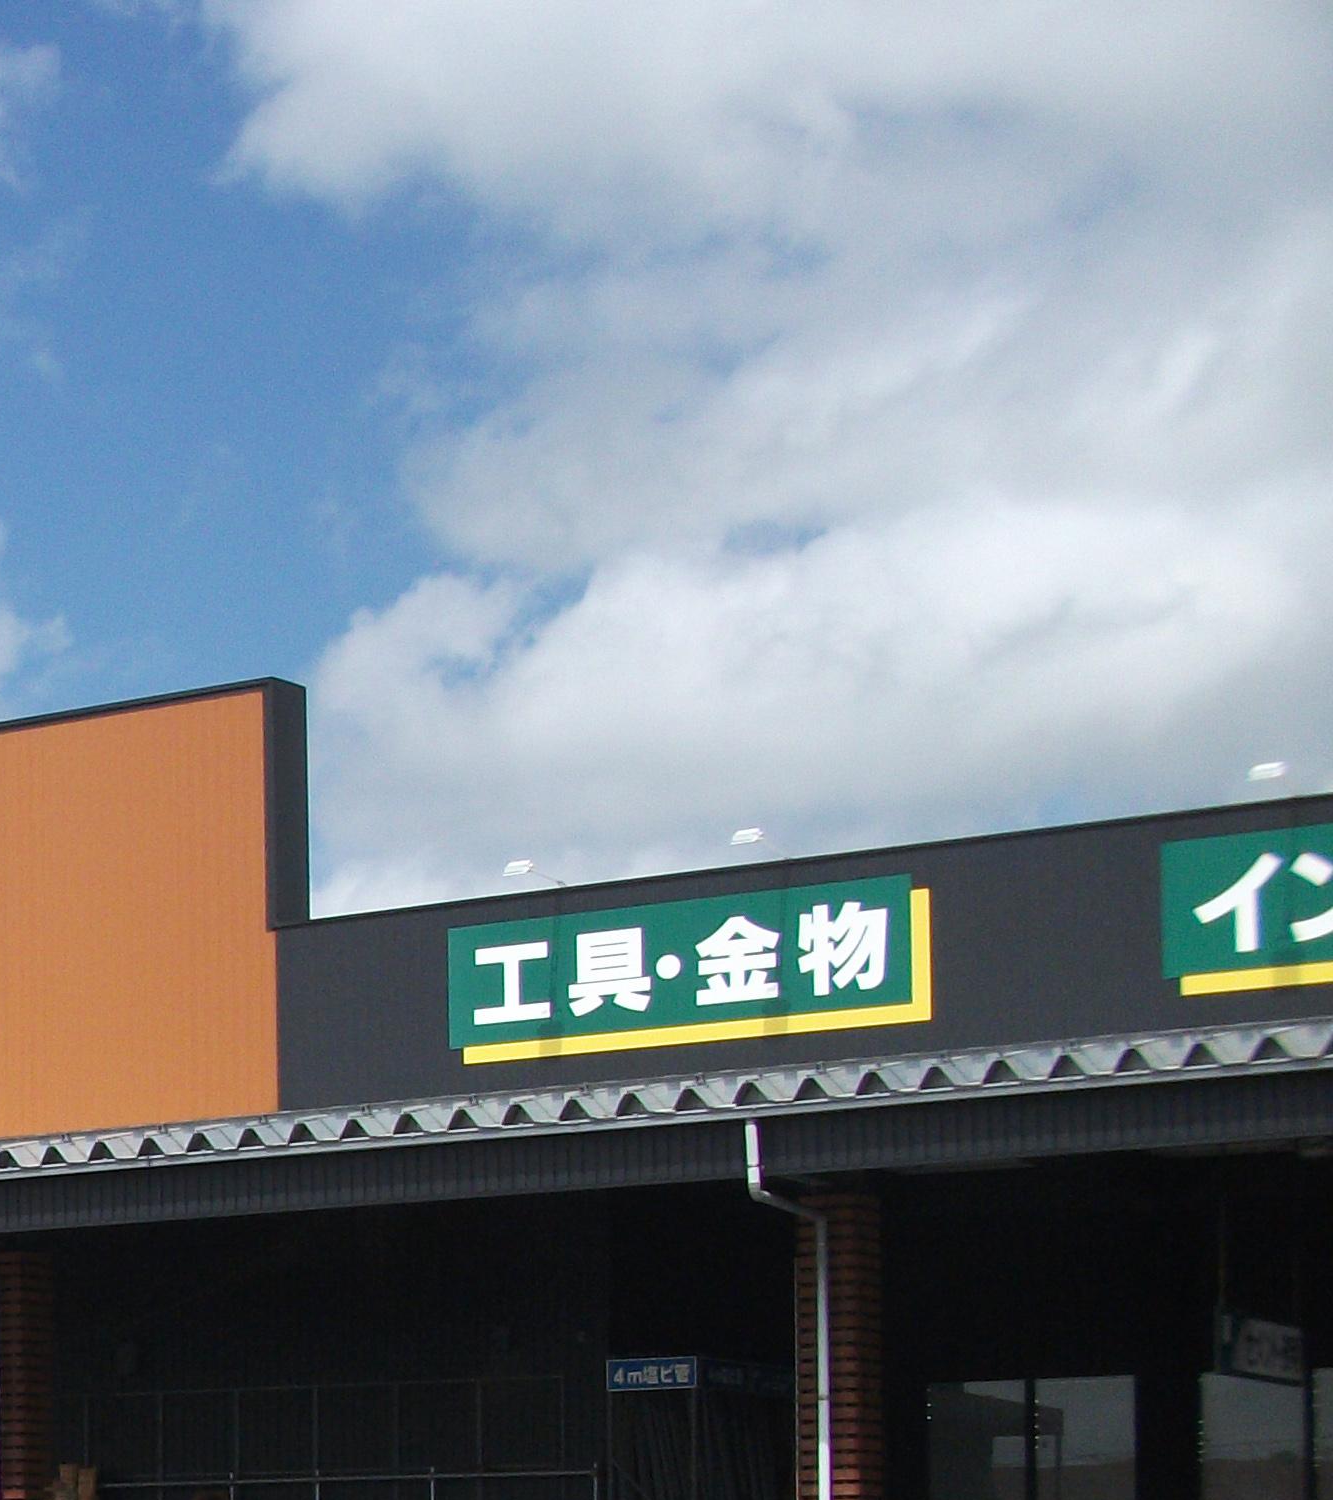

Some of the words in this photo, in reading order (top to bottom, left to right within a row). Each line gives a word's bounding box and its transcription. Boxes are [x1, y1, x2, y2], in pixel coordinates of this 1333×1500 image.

[472, 901, 890, 1026] 工具・金物
